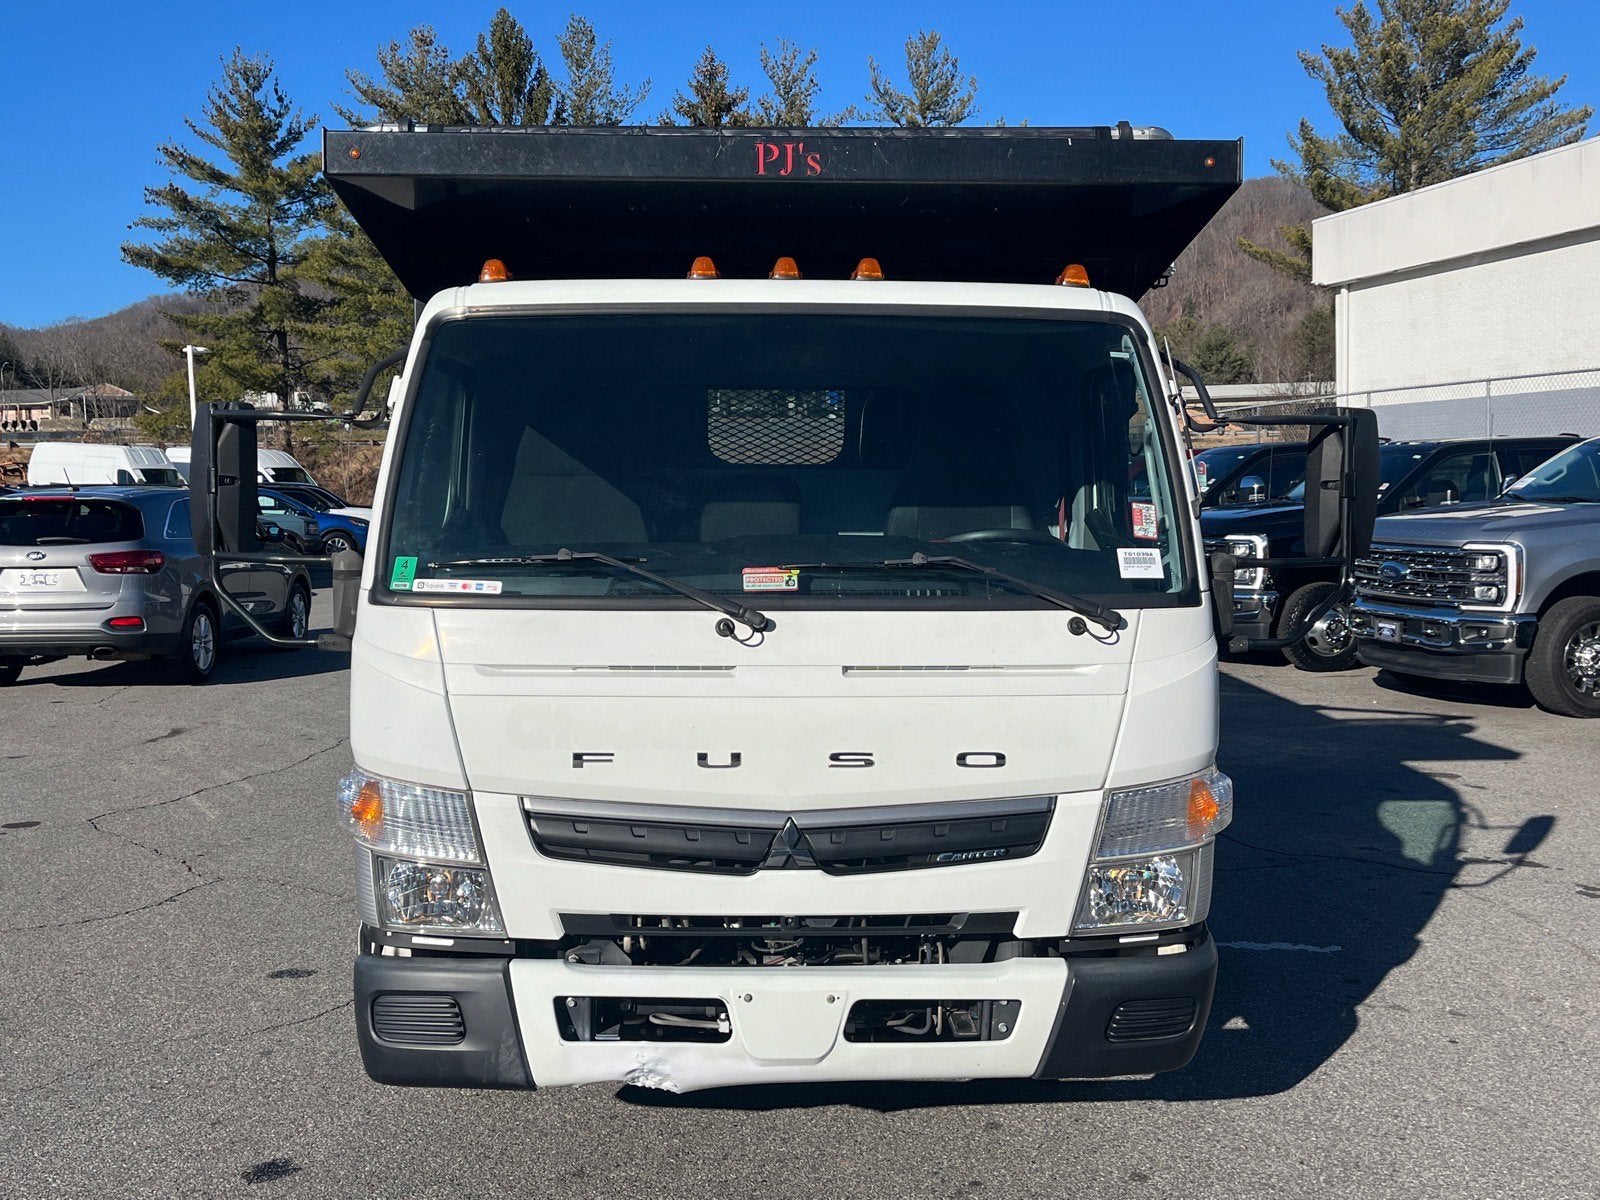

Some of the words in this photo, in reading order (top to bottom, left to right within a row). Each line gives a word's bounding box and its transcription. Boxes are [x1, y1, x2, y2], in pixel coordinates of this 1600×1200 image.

[754, 141, 822, 176] PJ's
[401, 560, 409, 570] 4
[572, 752, 1007, 769] FUSO
